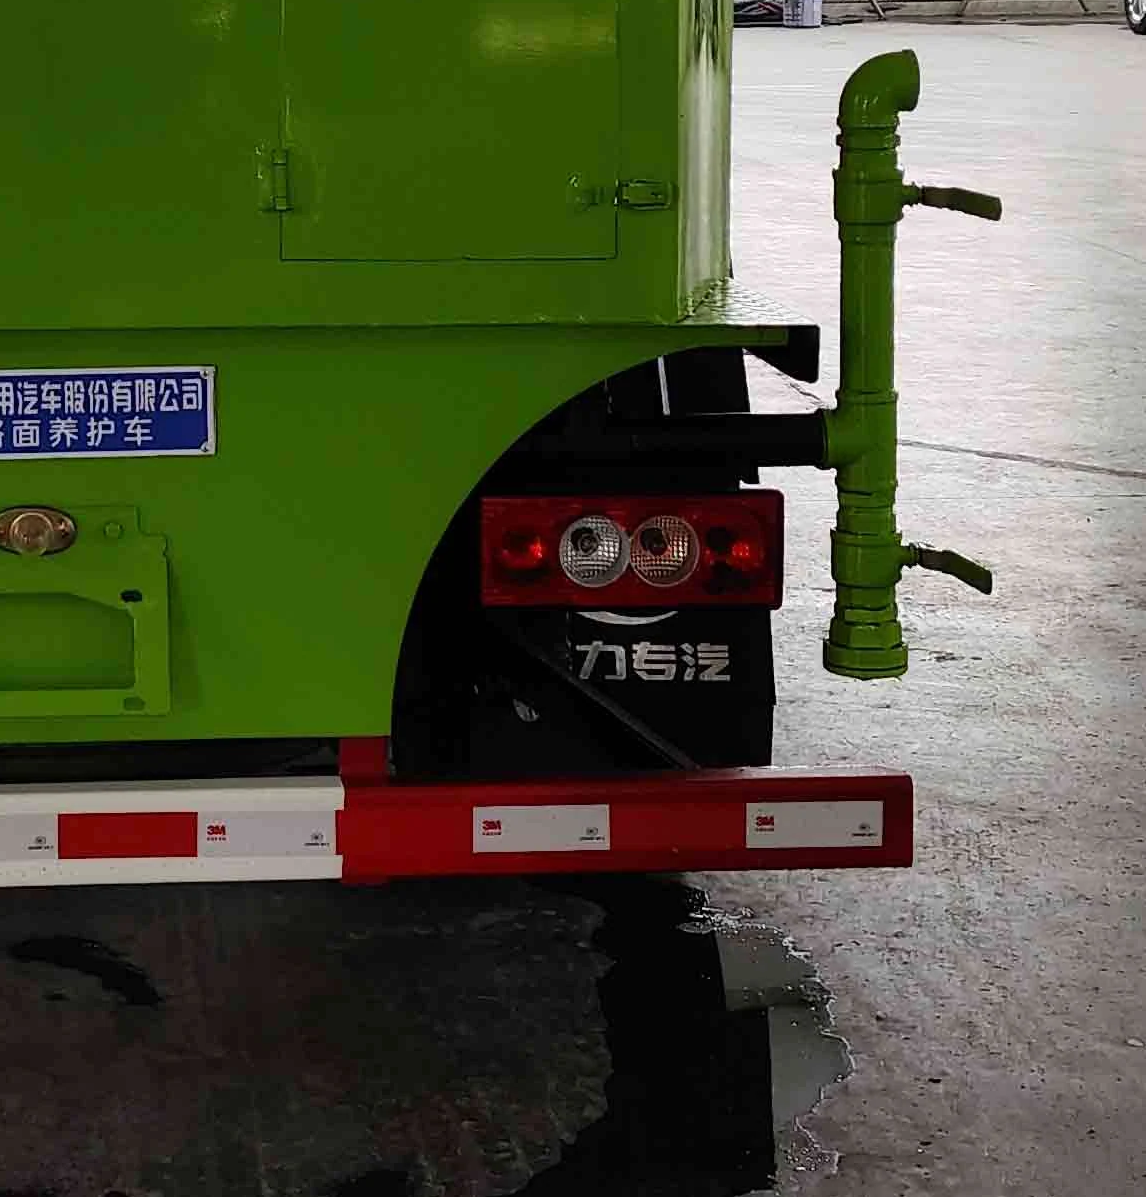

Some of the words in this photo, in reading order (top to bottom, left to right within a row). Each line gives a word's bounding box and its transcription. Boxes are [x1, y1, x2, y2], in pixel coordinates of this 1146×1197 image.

[566, 640, 731, 681] 力专汽
[207, 825, 226, 835] 3M
